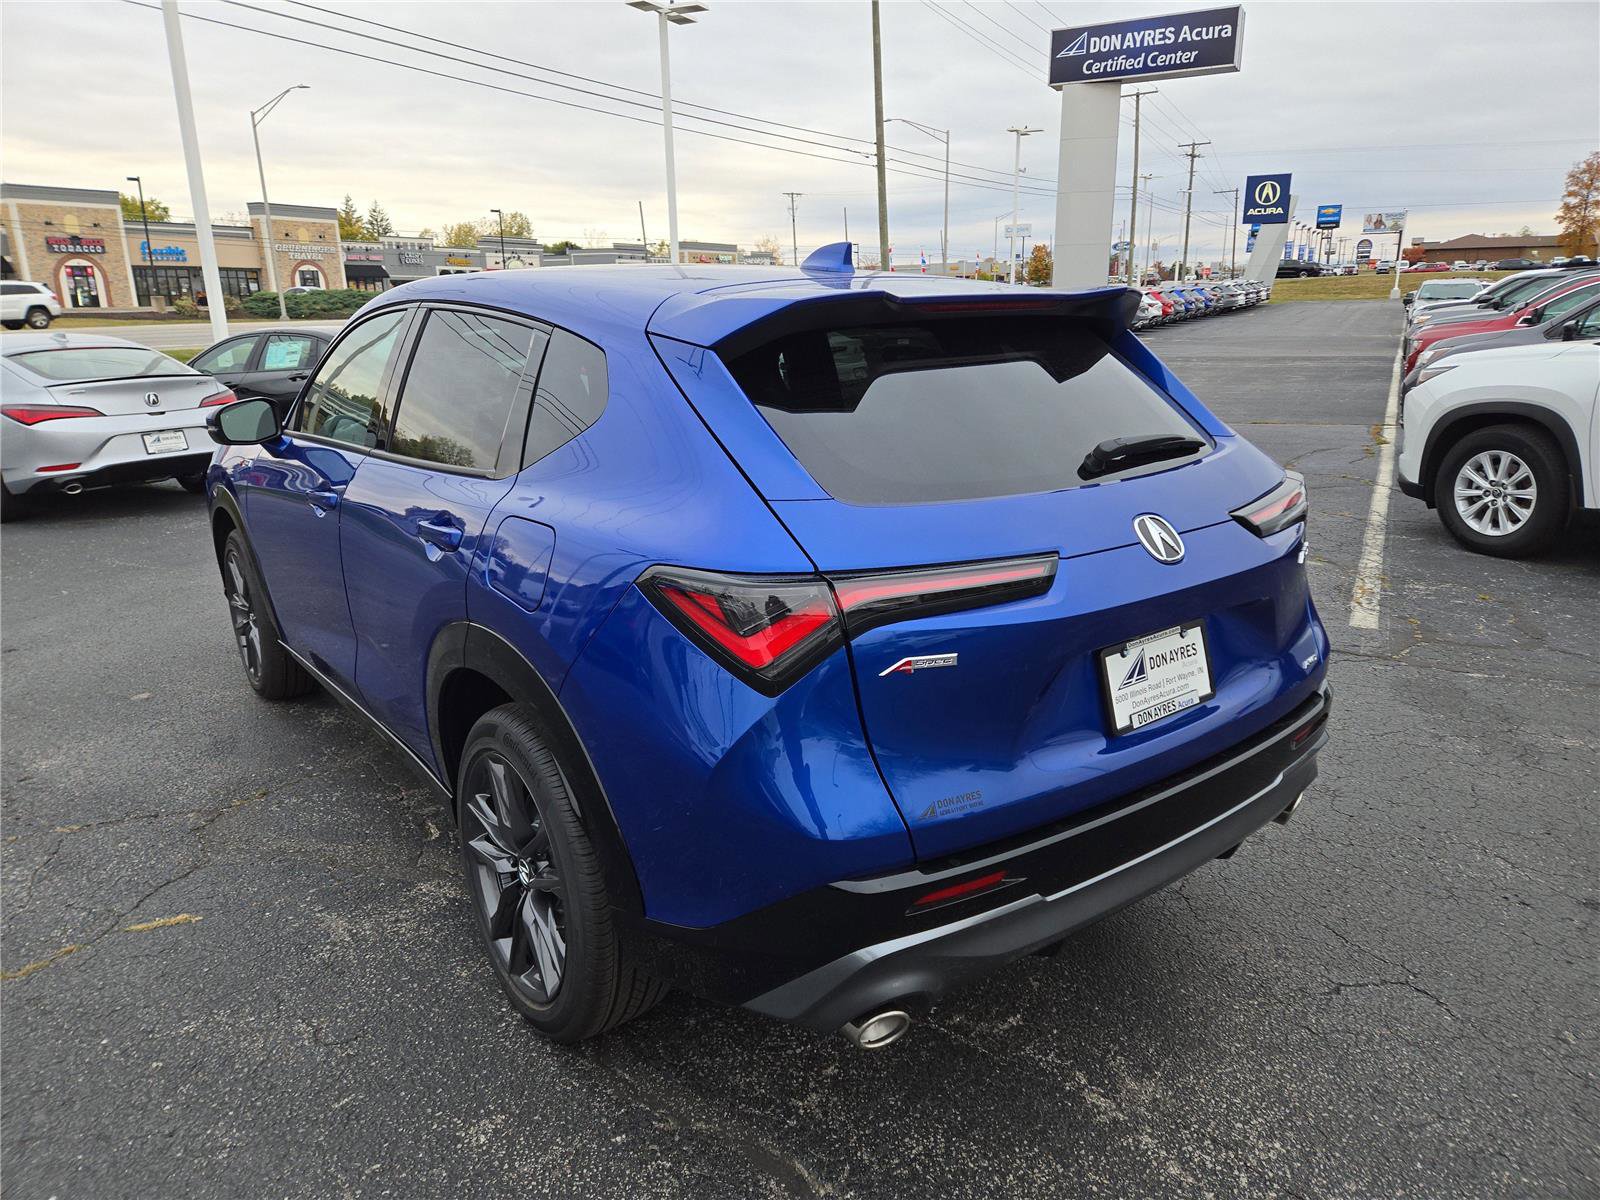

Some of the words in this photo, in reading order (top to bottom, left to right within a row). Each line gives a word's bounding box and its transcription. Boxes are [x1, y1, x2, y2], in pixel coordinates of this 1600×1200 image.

[1089, 34, 1122, 54] DON
[1123, 27, 1176, 49] AYRES
[1178, 23, 1232, 43] Acura
[1082, 52, 1146, 75] Certified
[1147, 49, 1199, 68] Center
[1247, 207, 1284, 216] ACURA
[52, 244, 102, 252] TOBACCO
[288, 252, 324, 261] TRAVEL
[1149, 652, 1168, 670] DON
[1169, 642, 1198, 664] AYRES
[1148, 680, 1162, 692] Road
[1166, 675, 1177, 686] Fort
[1138, 708, 1154, 724] DON
[1154, 700, 1176, 717] AYRES
[1177, 697, 1195, 709] Acura
[937, 797, 955, 809] DON
[955, 790, 982, 804] AYRES
